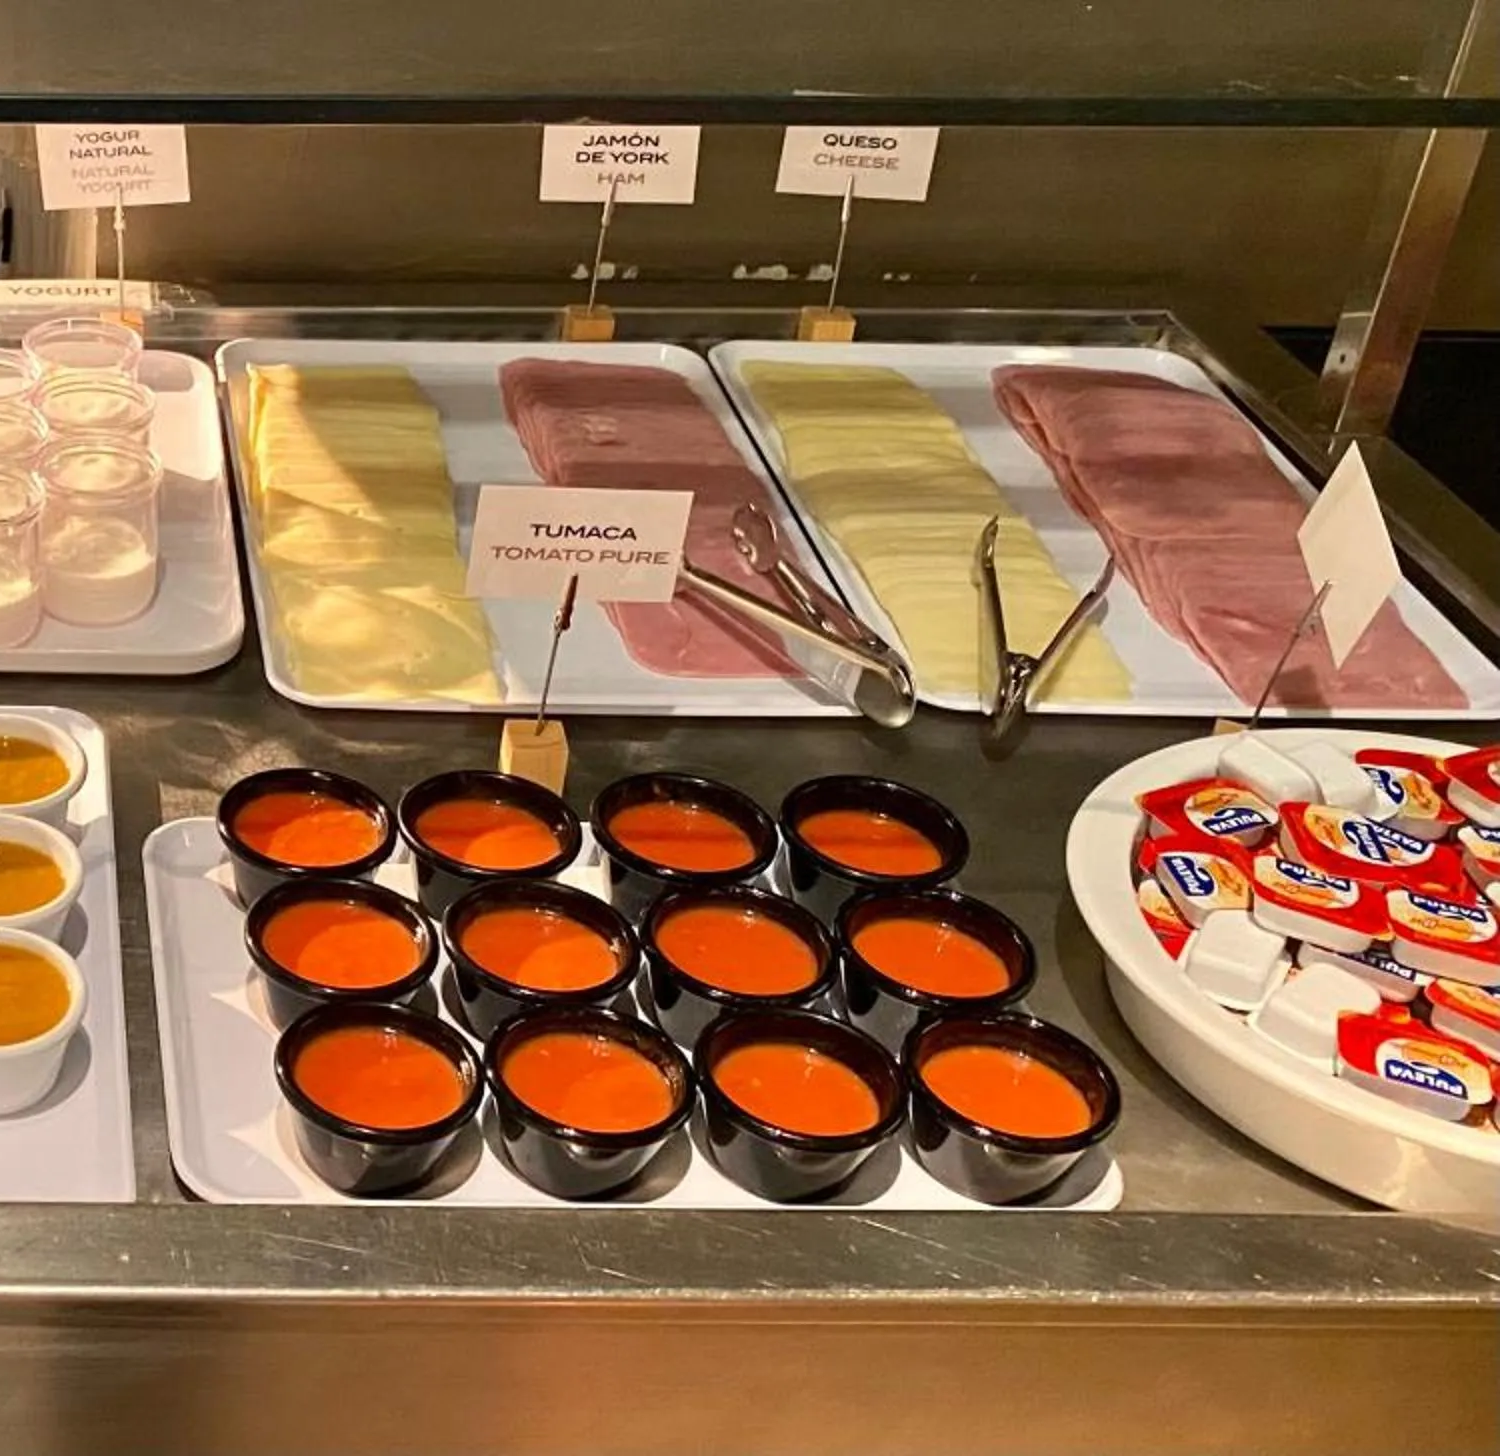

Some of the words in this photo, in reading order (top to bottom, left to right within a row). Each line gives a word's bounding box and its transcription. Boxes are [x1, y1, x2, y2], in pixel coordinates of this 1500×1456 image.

[74, 130, 140, 144] YOGUR
[583, 132, 660, 147] JAMÓN
[823, 133, 897, 150] QUESO
[69, 145, 153, 159] NATURAL
[575, 151, 605, 164] DE
[610, 151, 670, 165] YORK
[813, 153, 900, 170] CHEESE
[71, 164, 155, 180] NATURAL
[597, 172, 645, 185] HAM
[76, 179, 153, 194] YOGURT
[8, 286, 117, 297] YOGURT
[530, 523, 637, 541] TUMACA
[490, 545, 594, 562] TOMATO
[600, 549, 670, 565] PURE
[1389, 1064, 1463, 1095] PULEVA
